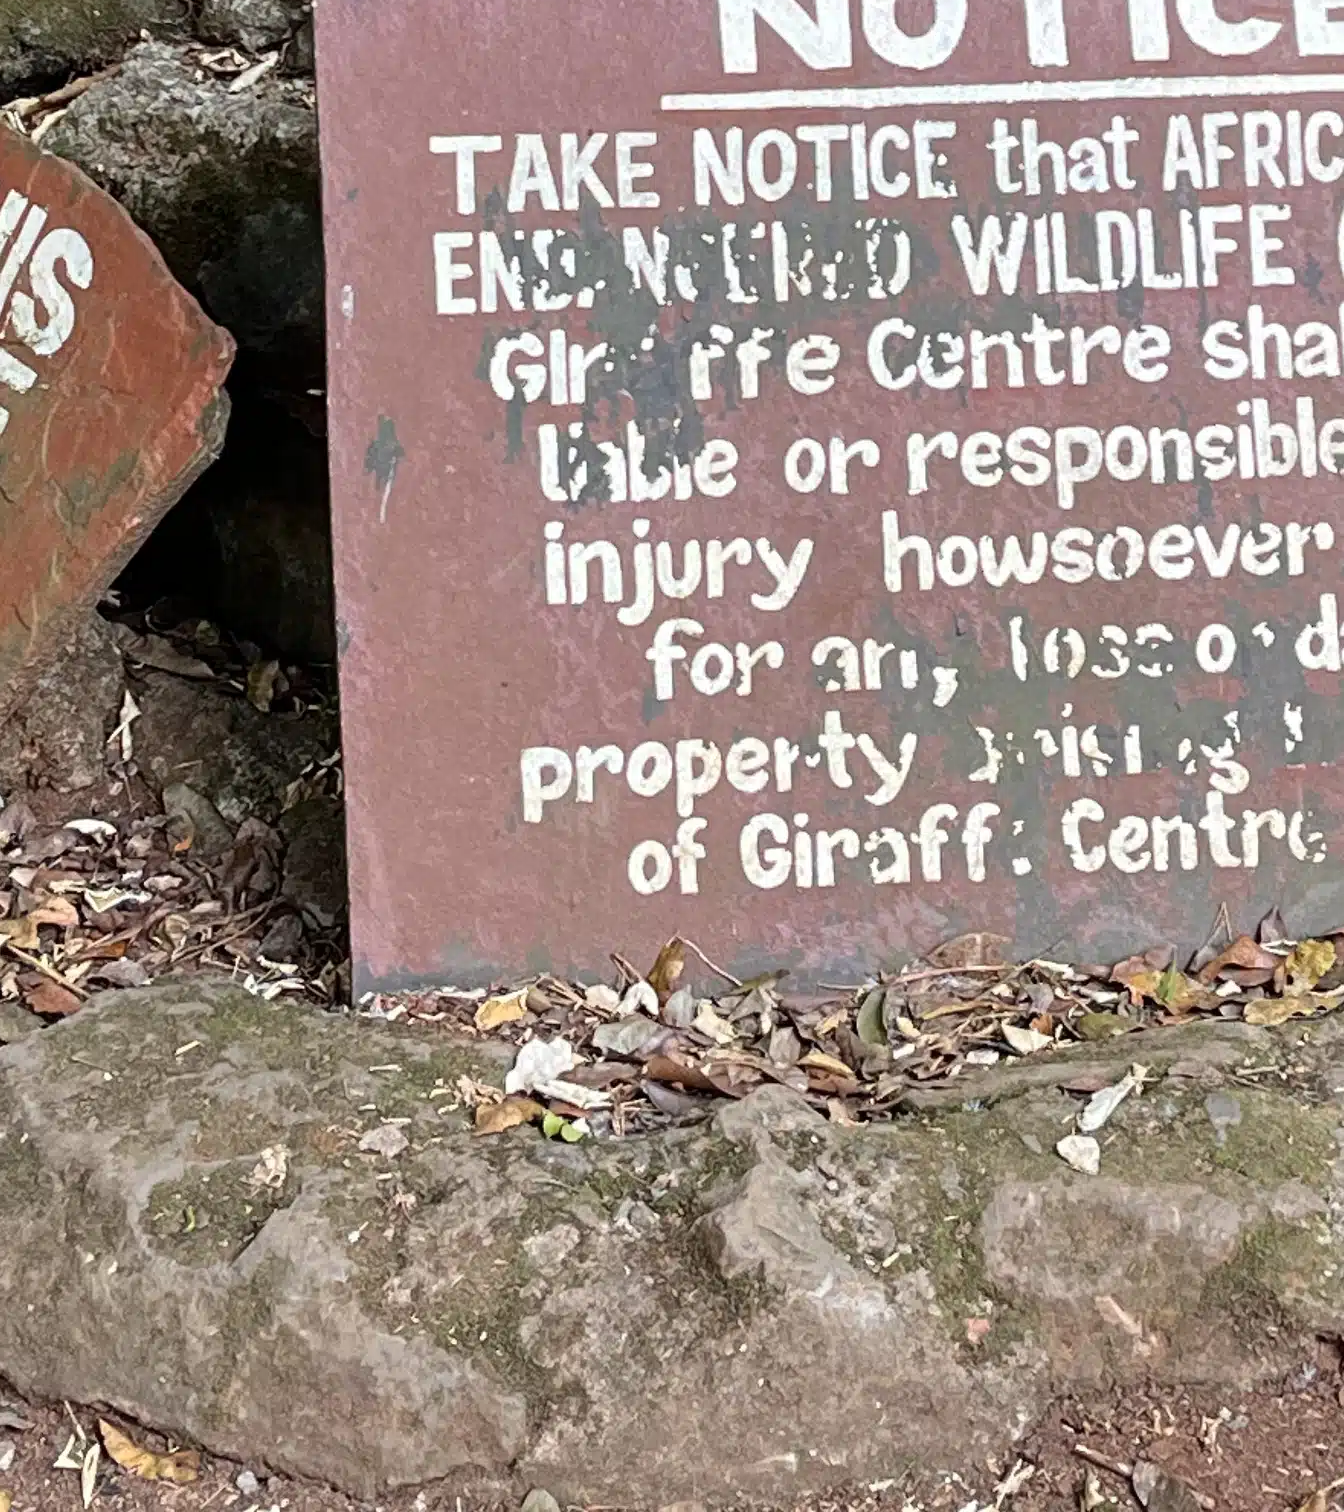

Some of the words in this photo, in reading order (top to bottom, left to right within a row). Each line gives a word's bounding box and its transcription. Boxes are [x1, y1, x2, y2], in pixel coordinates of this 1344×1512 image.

[430, 134, 659, 215] TAKE
[693, 118, 958, 206] NOTICE
[986, 115, 1139, 196] that
[951, 210, 1296, 292] WILDLIFE
[867, 313, 1171, 392] Centre
[784, 428, 880, 495] or
[543, 518, 814, 625] injury
[883, 510, 1336, 590] howsoever
[645, 613, 784, 700] for
[520, 710, 917, 823] property
[627, 816, 707, 896] of
